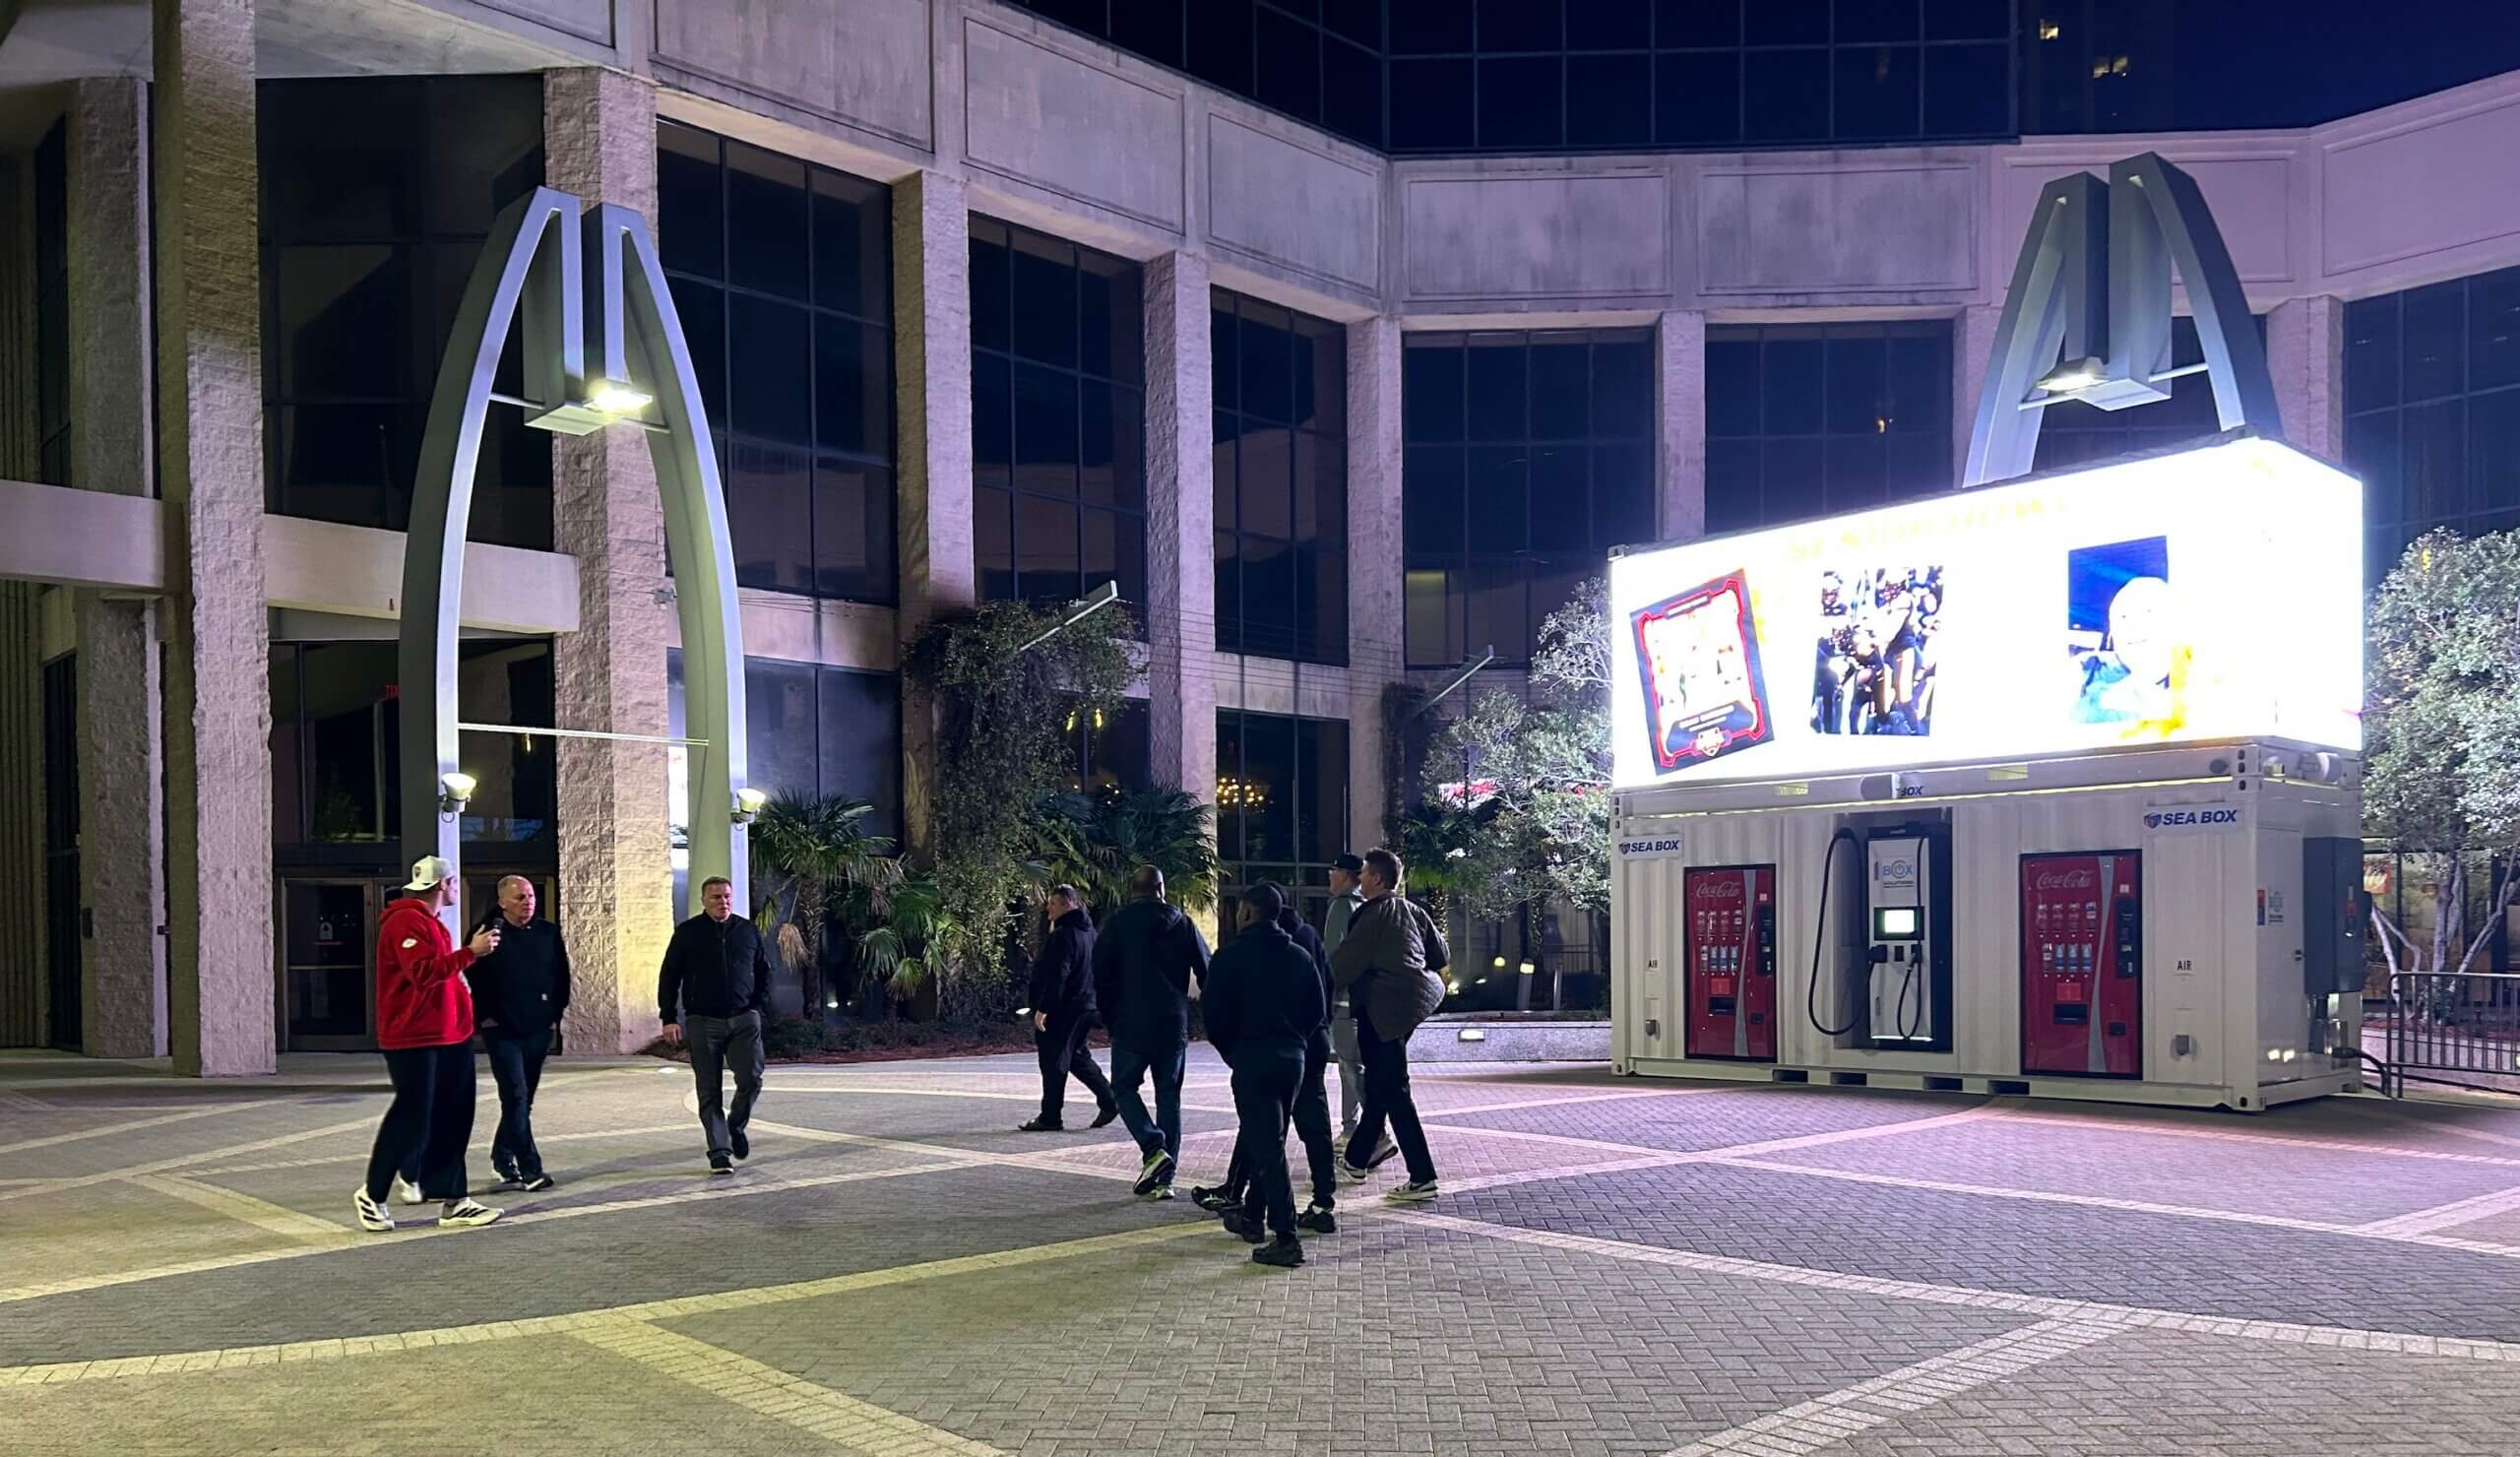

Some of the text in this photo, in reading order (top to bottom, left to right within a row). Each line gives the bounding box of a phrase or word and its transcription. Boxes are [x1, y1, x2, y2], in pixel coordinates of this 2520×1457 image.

[2163, 809, 2238, 826] SEA BOX
[1630, 840, 1679, 853] SEA BOX
[1648, 960, 1659, 969] AIR
[2176, 960, 2192, 971] AIR
